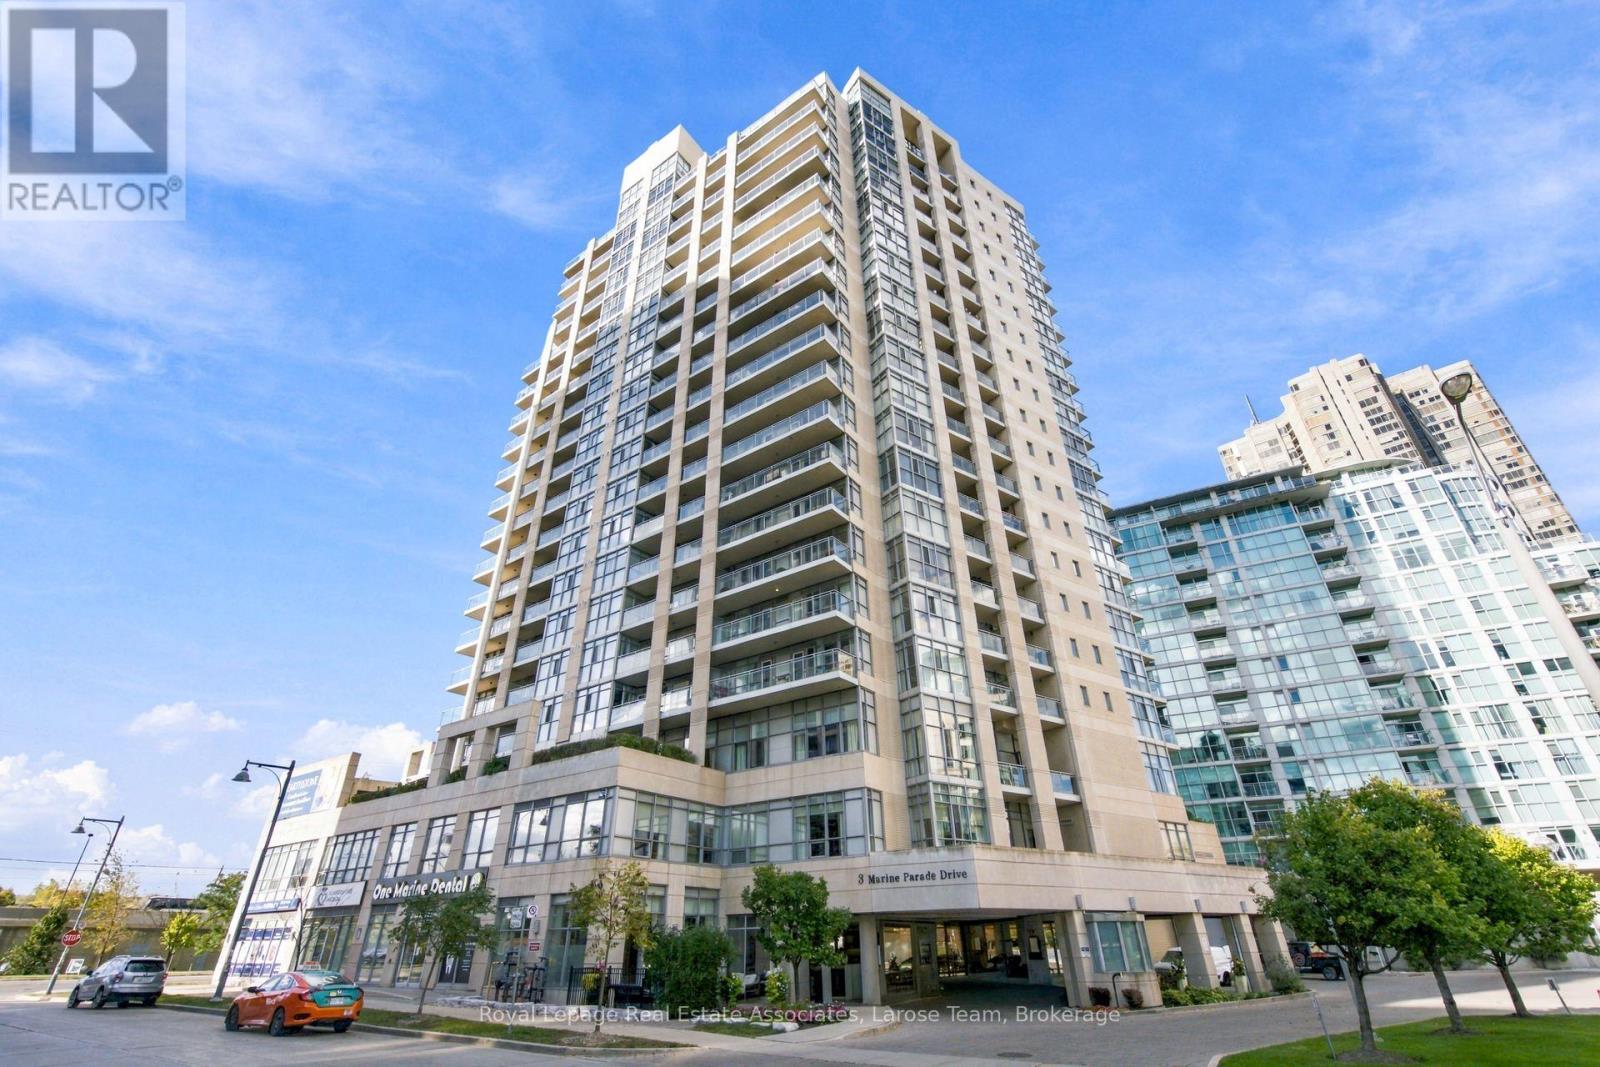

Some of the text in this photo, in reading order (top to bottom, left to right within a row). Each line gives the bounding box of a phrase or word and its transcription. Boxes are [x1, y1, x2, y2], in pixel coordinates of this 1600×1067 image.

[858, 869, 968, 885] 3 Marine Parade Drive
[373, 884, 392, 900] One
[393, 880, 428, 898] Marine
[430, 875, 469, 894] Dental
[63, 934, 80, 942] STOP
